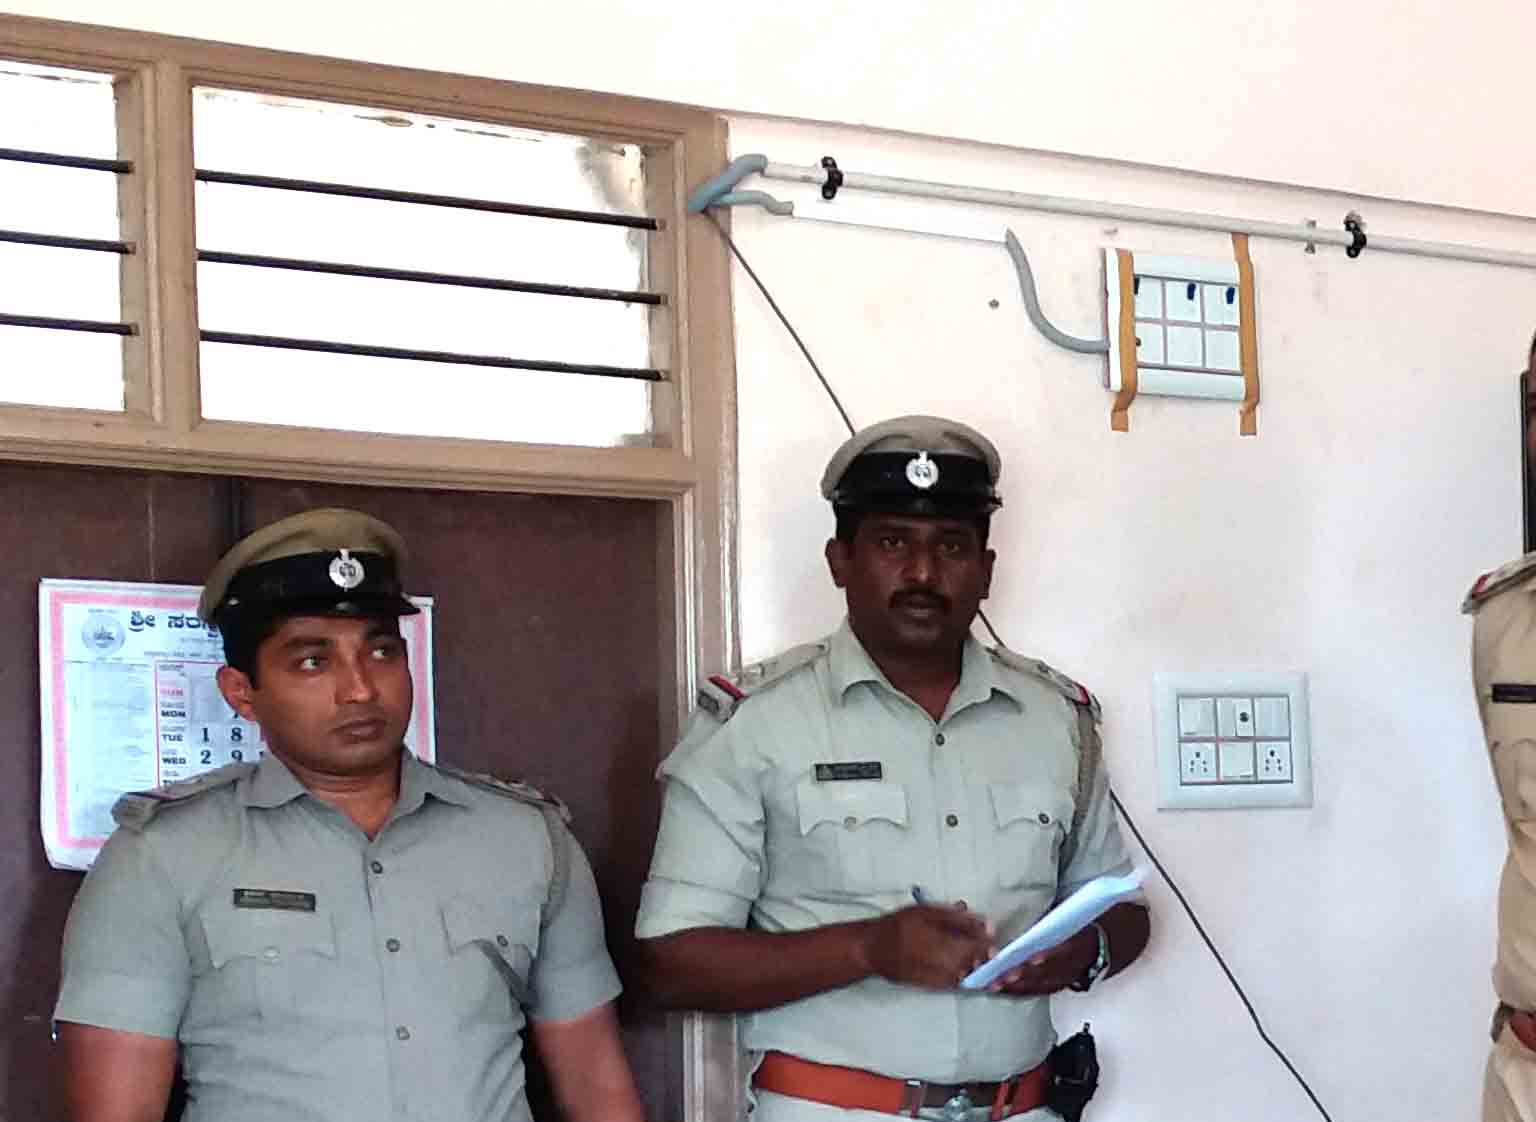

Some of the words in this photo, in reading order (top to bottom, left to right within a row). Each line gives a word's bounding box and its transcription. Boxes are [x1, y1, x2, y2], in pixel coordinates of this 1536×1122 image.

[161, 710, 186, 718] MON
[162, 734, 184, 742] TUE
[202, 727, 210, 742] 1
[230, 727, 243, 742] 8
[162, 757, 186, 765] WED
[200, 750, 211, 765] 2
